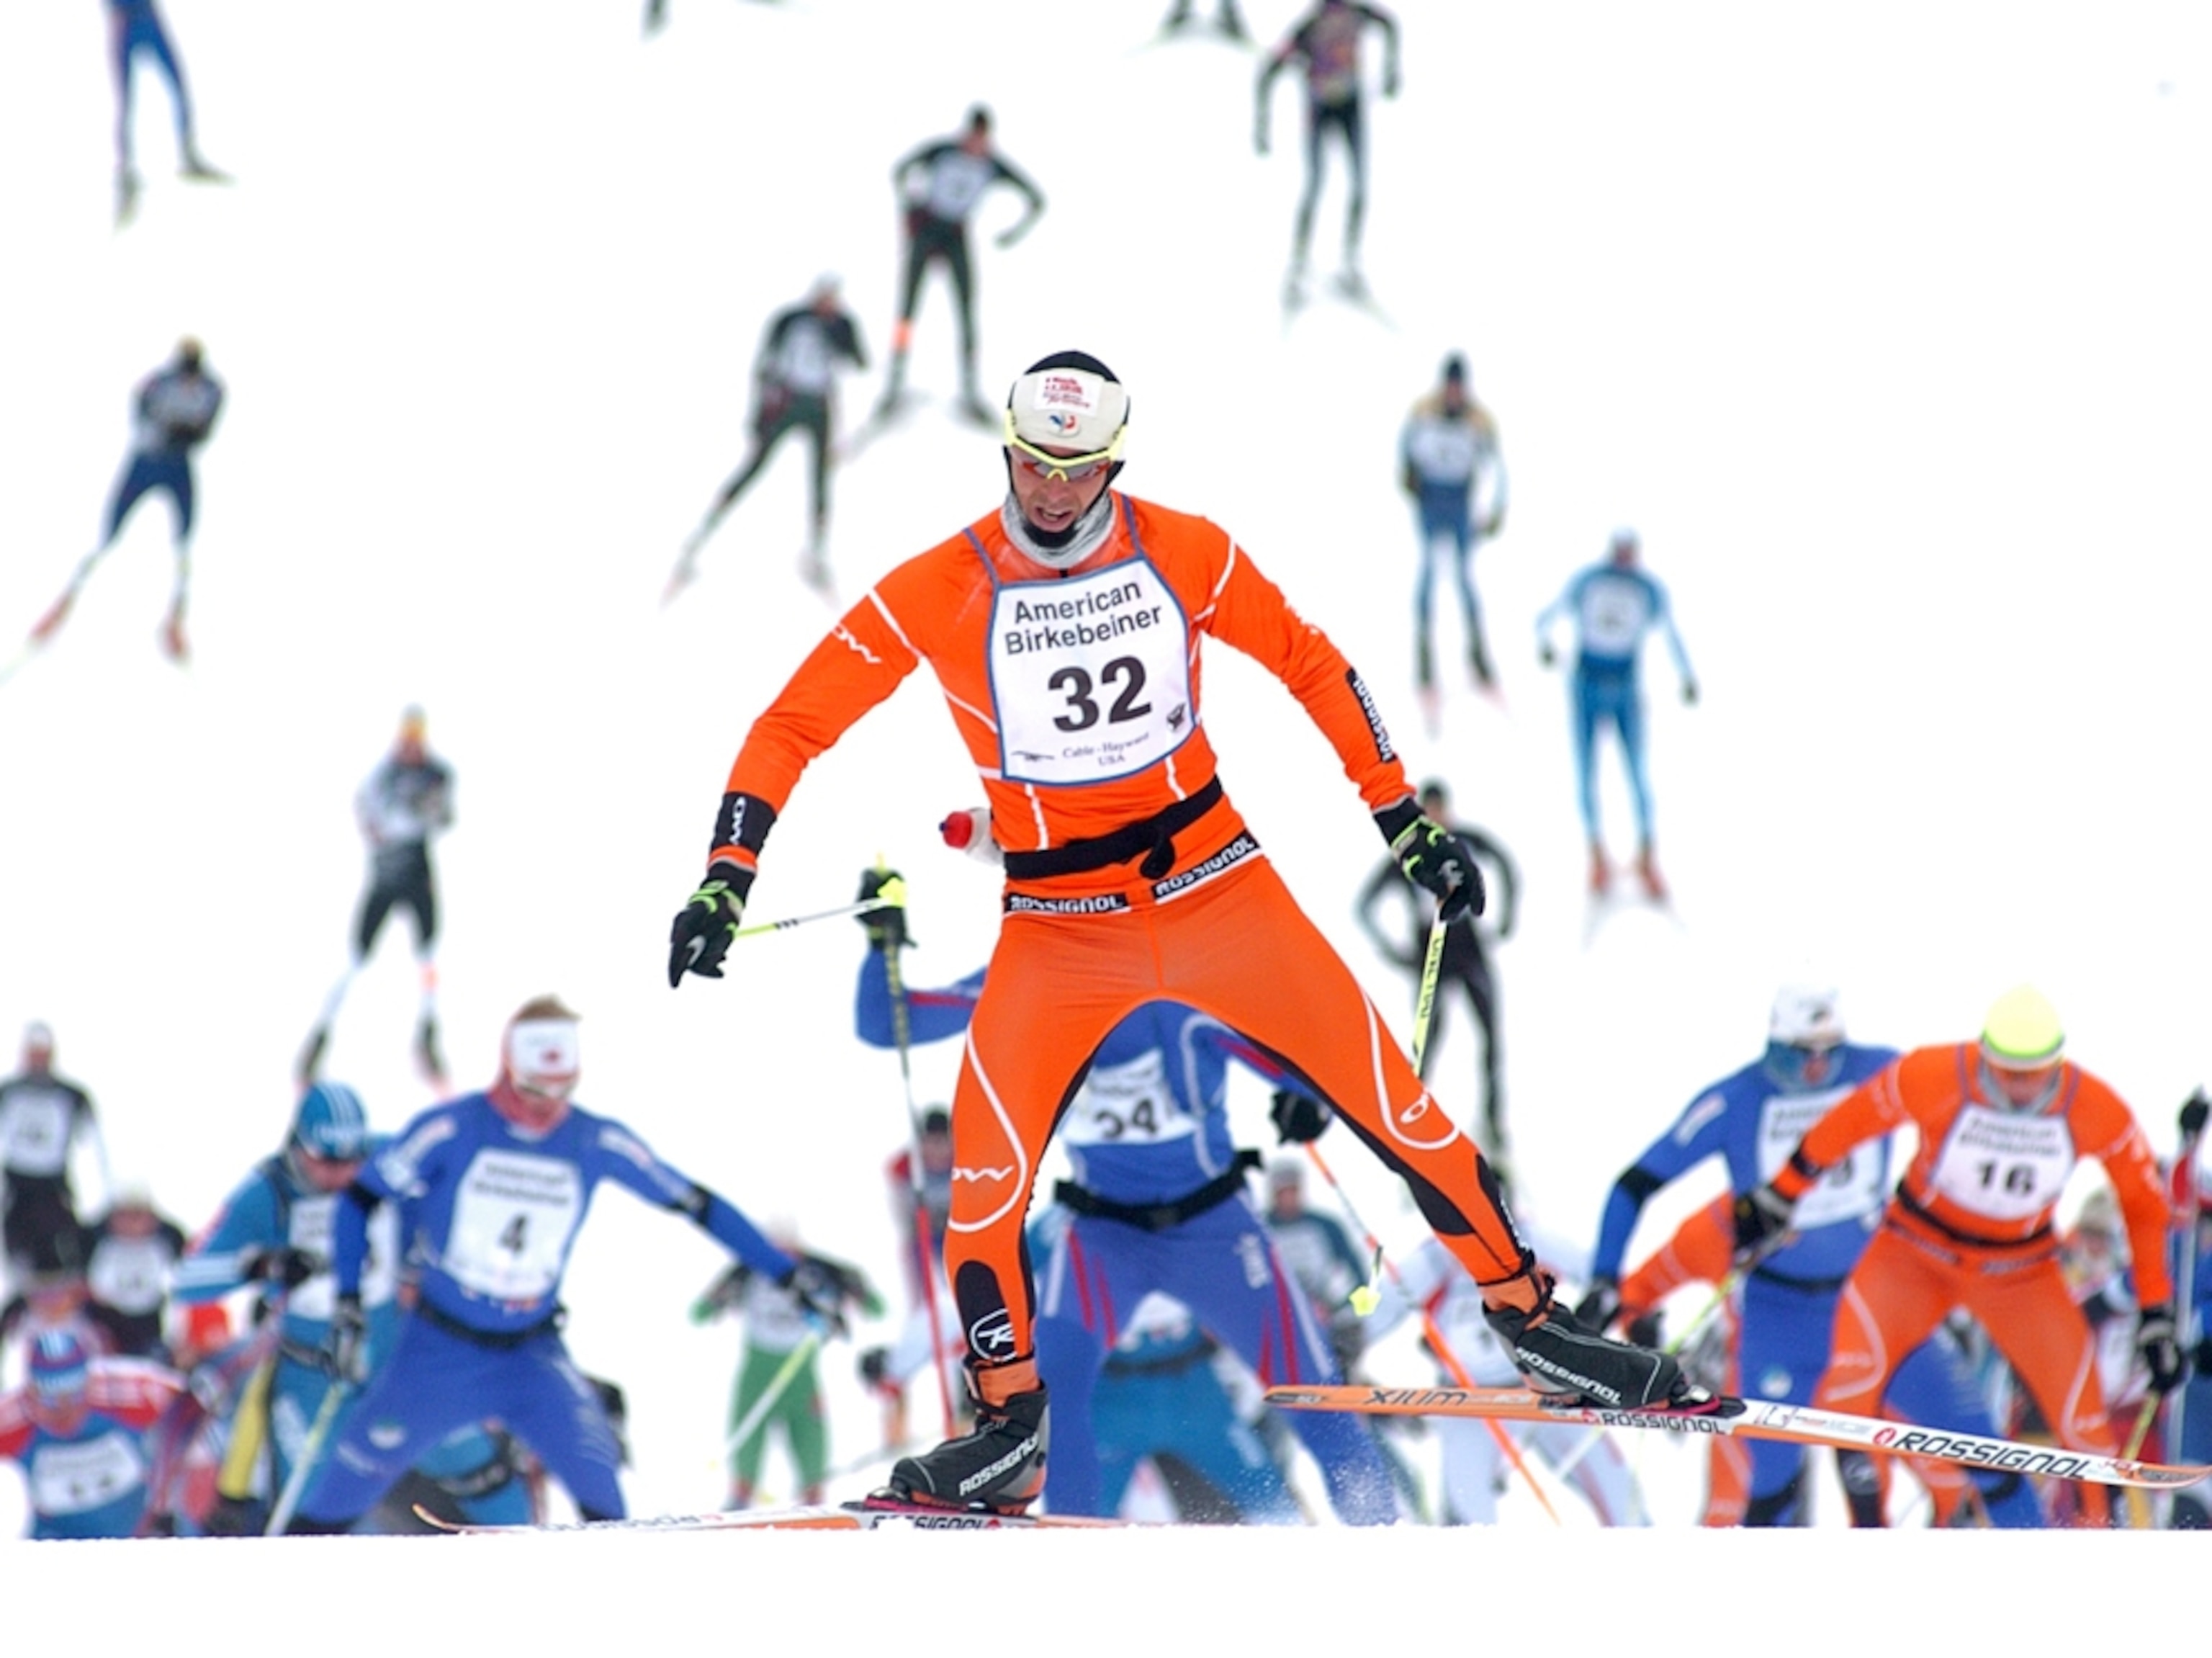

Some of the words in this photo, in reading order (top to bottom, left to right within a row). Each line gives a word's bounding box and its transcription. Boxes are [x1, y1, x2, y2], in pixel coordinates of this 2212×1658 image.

[1015, 582, 1141, 624] American
[1005, 606, 1161, 655] Birkebeiner
[1048, 655, 1152, 733] 32
[1098, 753, 1126, 766] USA
[1155, 835, 1255, 896] ROSSIGNOL
[1010, 895, 1125, 914] ROSSIGNOL
[1978, 1162, 2036, 1197] 16
[498, 1214, 527, 1255] 4
[1515, 1346, 1623, 1407] ROSSIGNOL
[1601, 1412, 1726, 1435] ROSSIGNOL
[959, 1431, 1038, 1497] ROSSIGNOL
[1893, 1431, 2091, 1480] ROSSIGNOL
